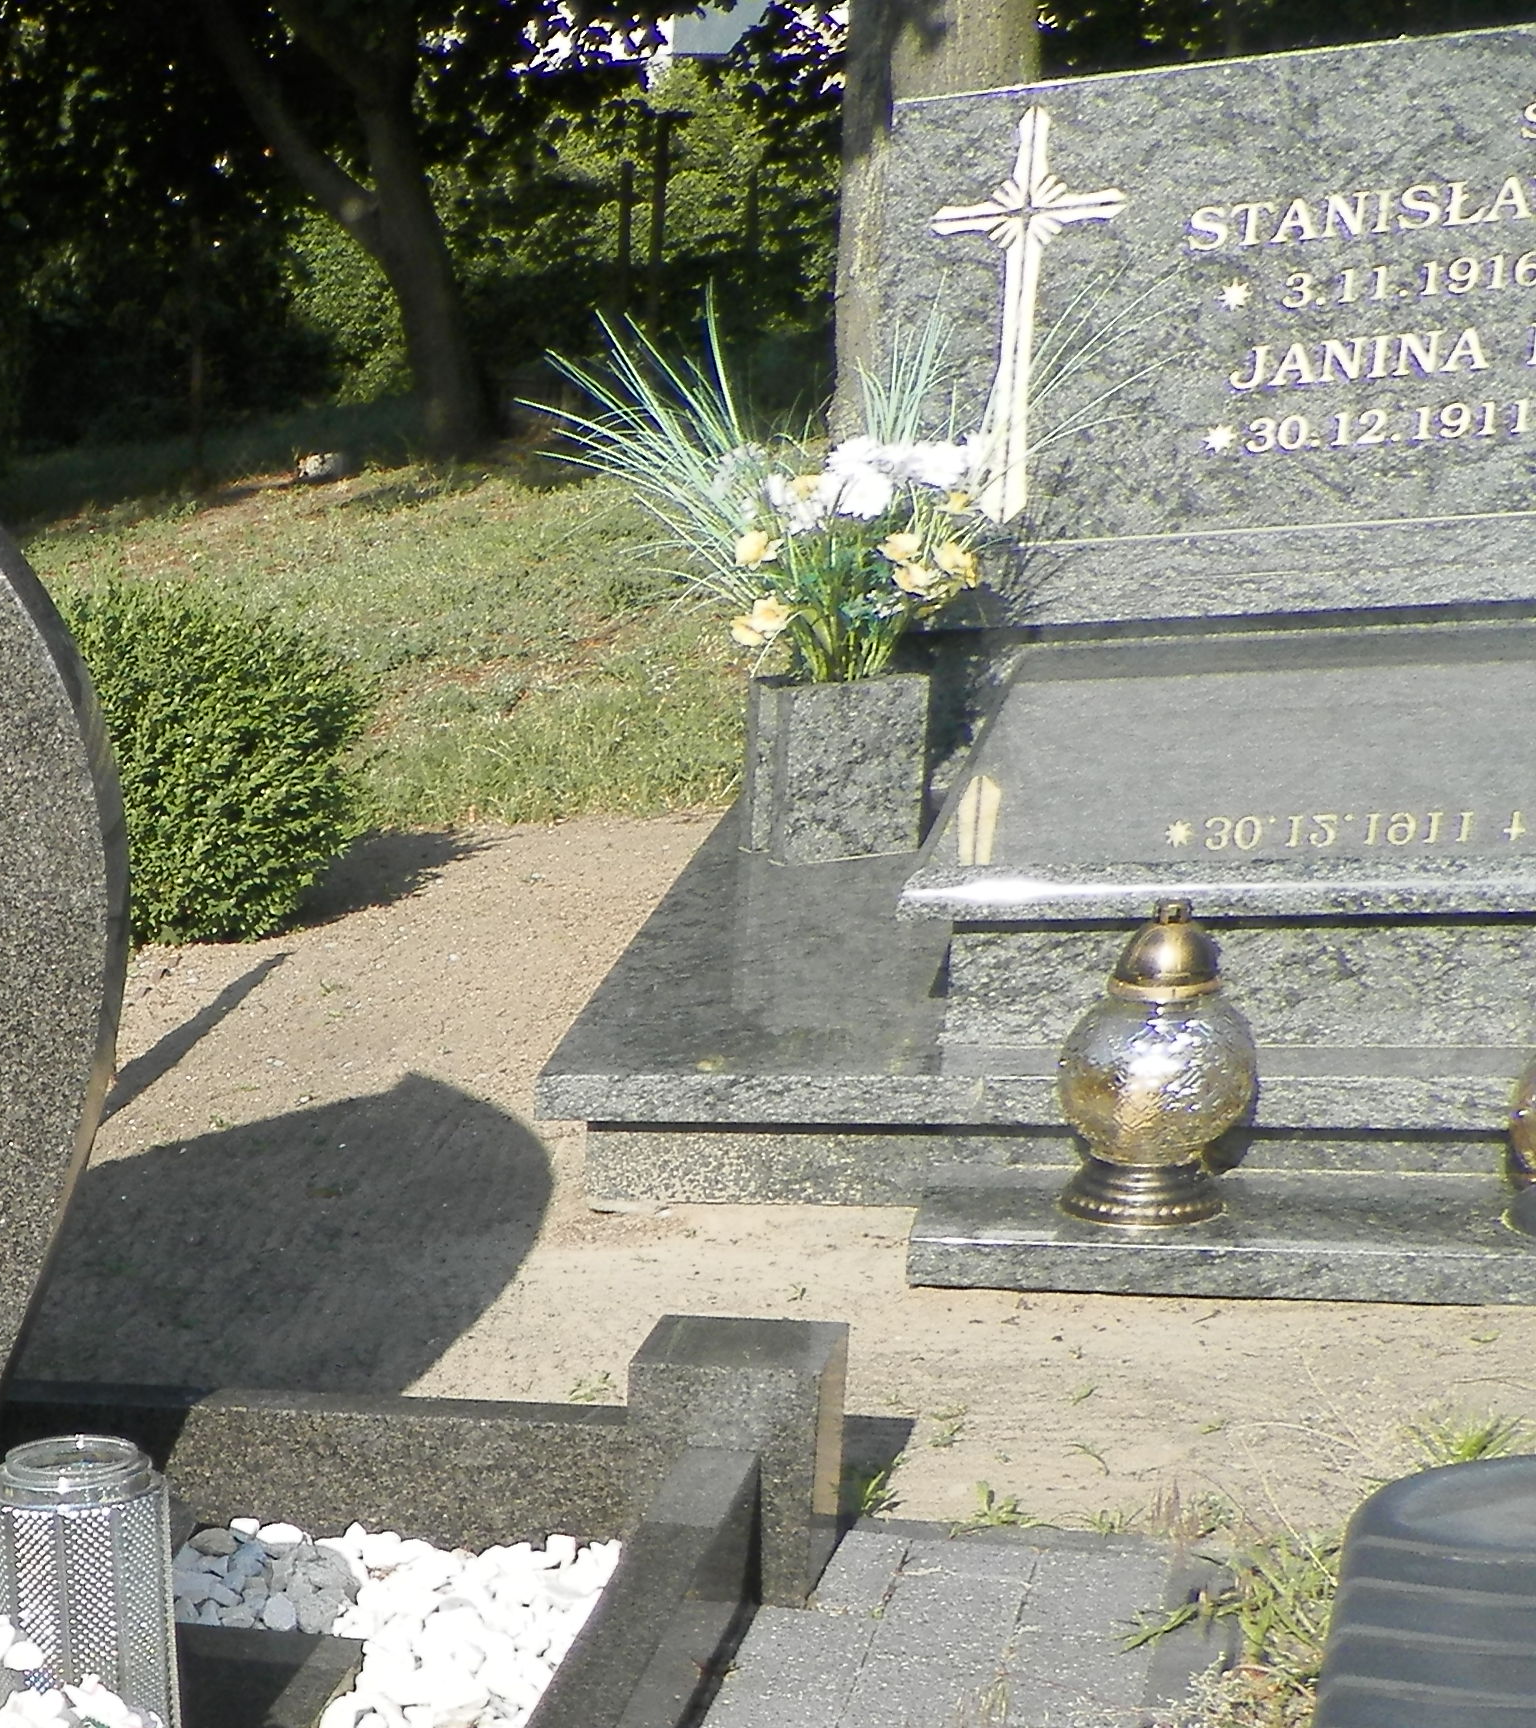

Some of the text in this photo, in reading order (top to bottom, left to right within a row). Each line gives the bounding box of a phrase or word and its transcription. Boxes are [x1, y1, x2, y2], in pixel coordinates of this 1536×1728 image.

[1187, 175, 1536, 252] STANISŁA
[1282, 251, 1536, 309] 3.11.1916
[1230, 326, 1490, 391] JANINA
[1245, 399, 1531, 453] 30.12.1911
